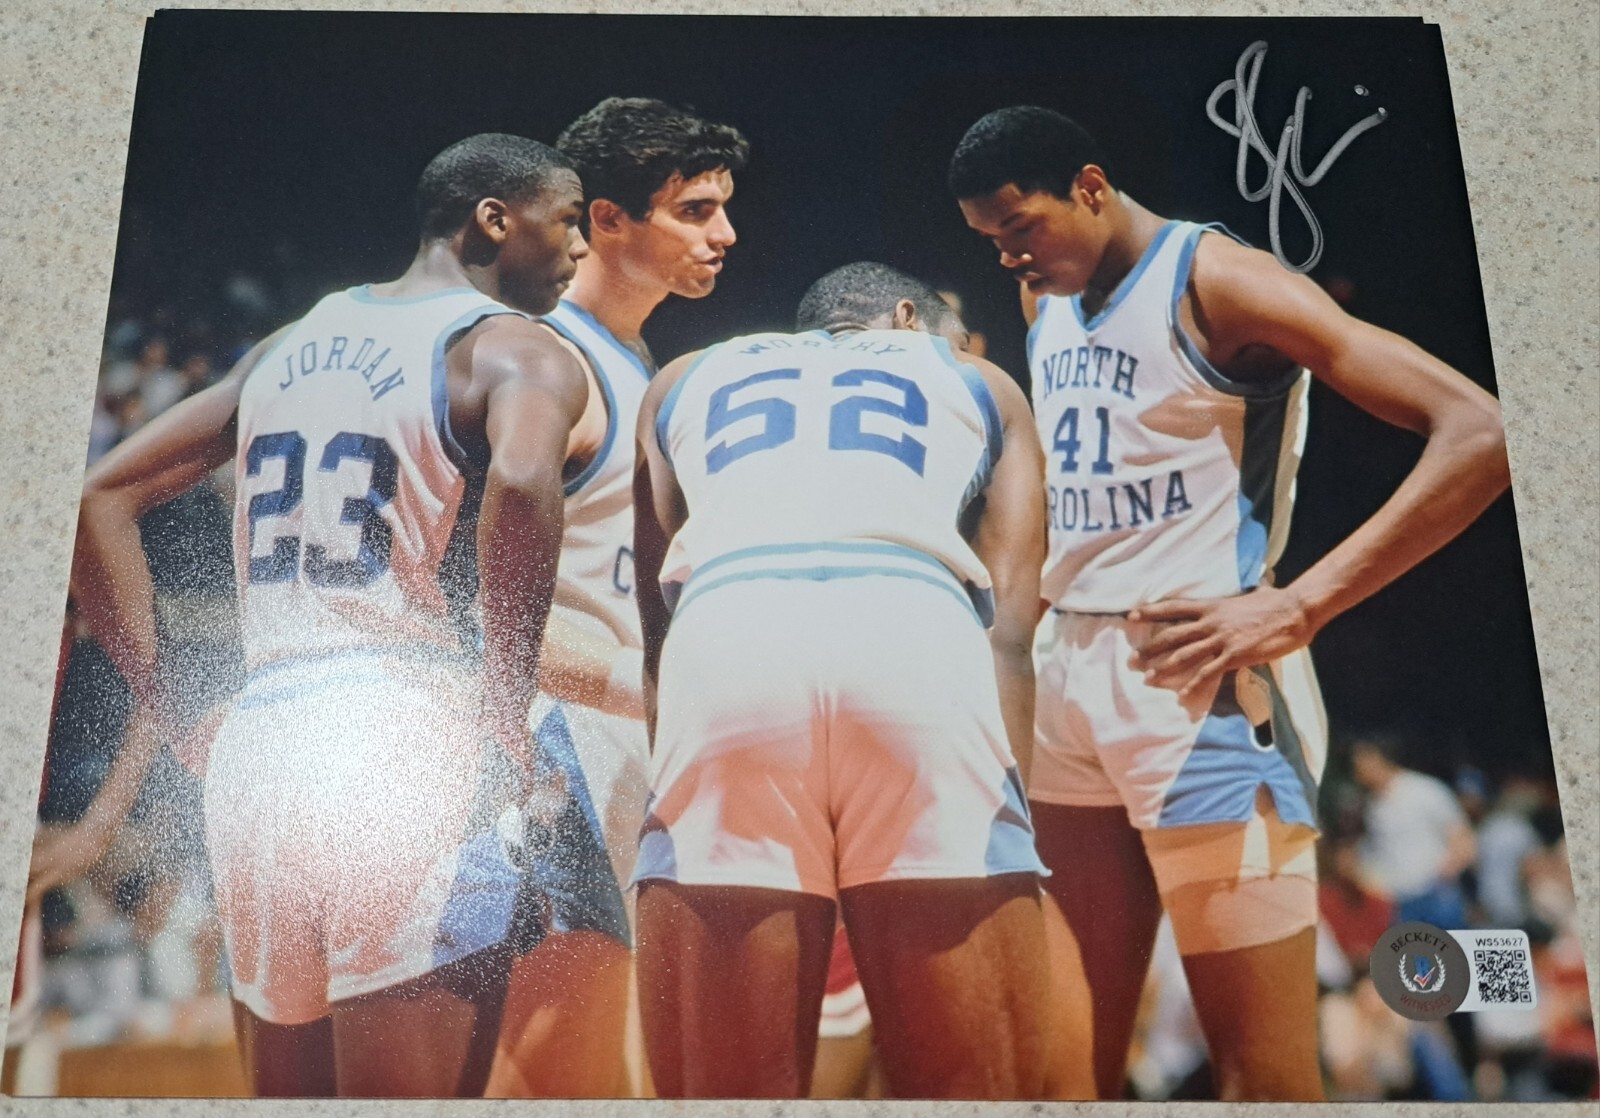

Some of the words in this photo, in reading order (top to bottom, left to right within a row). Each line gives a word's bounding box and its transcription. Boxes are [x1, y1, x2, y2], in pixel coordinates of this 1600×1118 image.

[279, 336, 405, 401] JORDAN
[1043, 345, 1139, 400] NORTH
[705, 367, 929, 479] 52
[1052, 406, 1114, 475] 41
[246, 430, 400, 589] 23
[1390, 932, 1449, 953] BECKETT
[1475, 937, 1523, 947] WS53627
